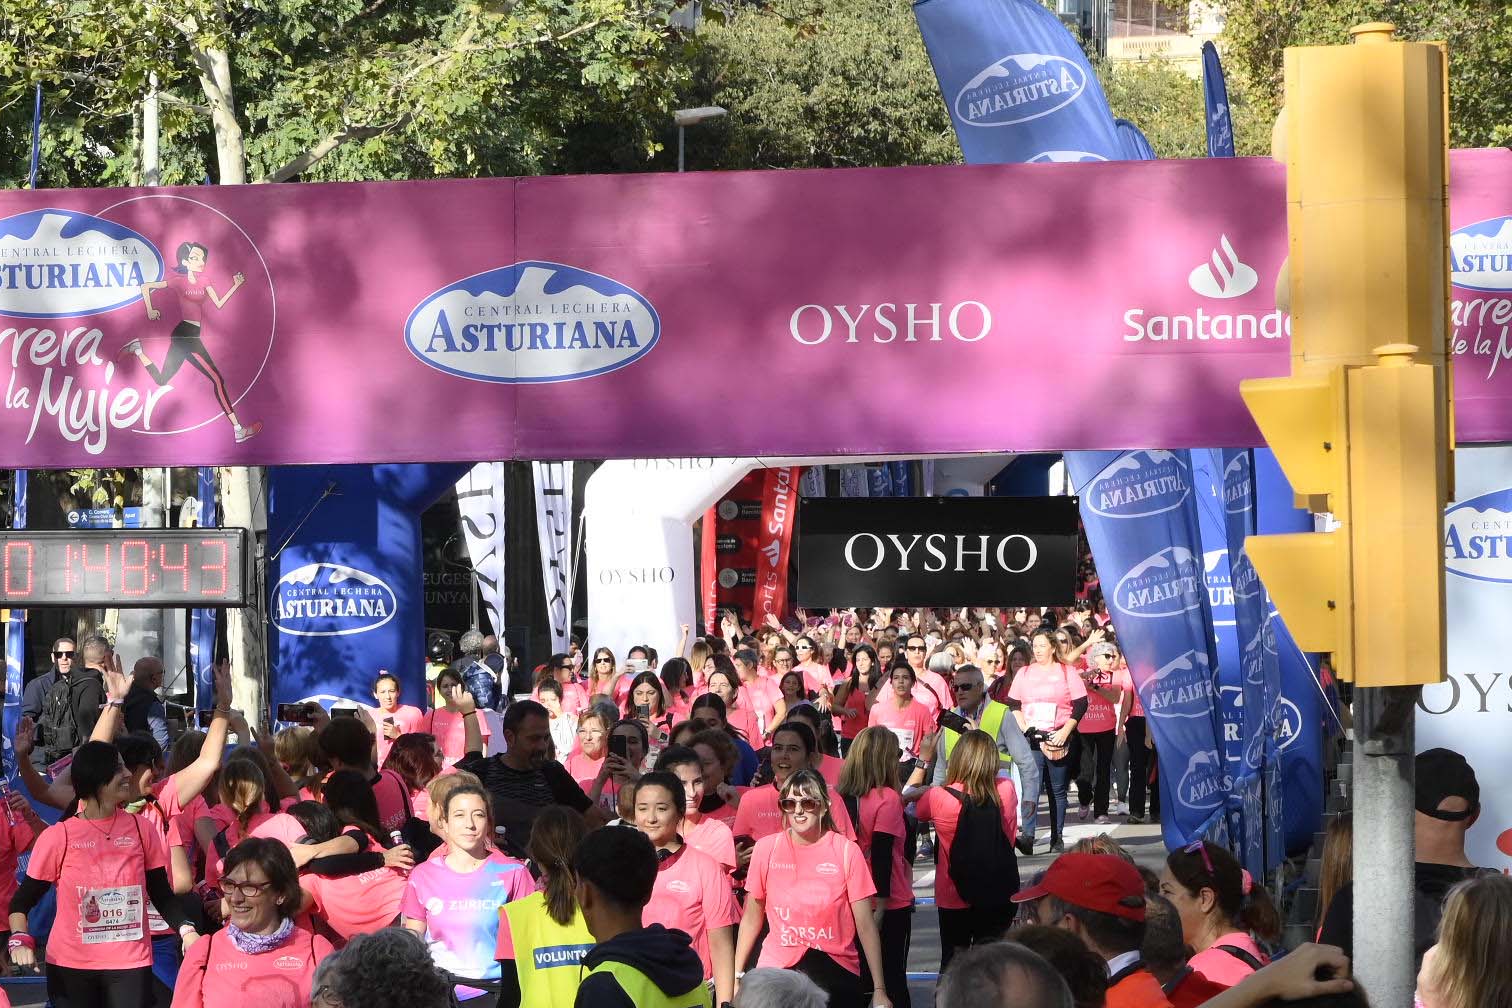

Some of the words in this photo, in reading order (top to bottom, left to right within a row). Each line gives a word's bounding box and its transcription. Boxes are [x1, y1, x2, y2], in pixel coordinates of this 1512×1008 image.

[66, 244, 140, 257] LECHERA
[464, 303, 542, 316] CENTRAL
[549, 302, 632, 315] LECHERA
[426, 309, 641, 354] ASTURIANA
[789, 301, 993, 345] OYSHO
[5, 373, 30, 409] la
[25, 360, 174, 455] Mujer
[845, 532, 1038, 573] OYSHO
[599, 566, 675, 585] OYSHO
[286, 588, 329, 597] CENTRAL
[334, 587, 383, 596] LECHERA
[274, 593, 388, 621] ASTURIANA
[102, 908, 123, 918] 016
